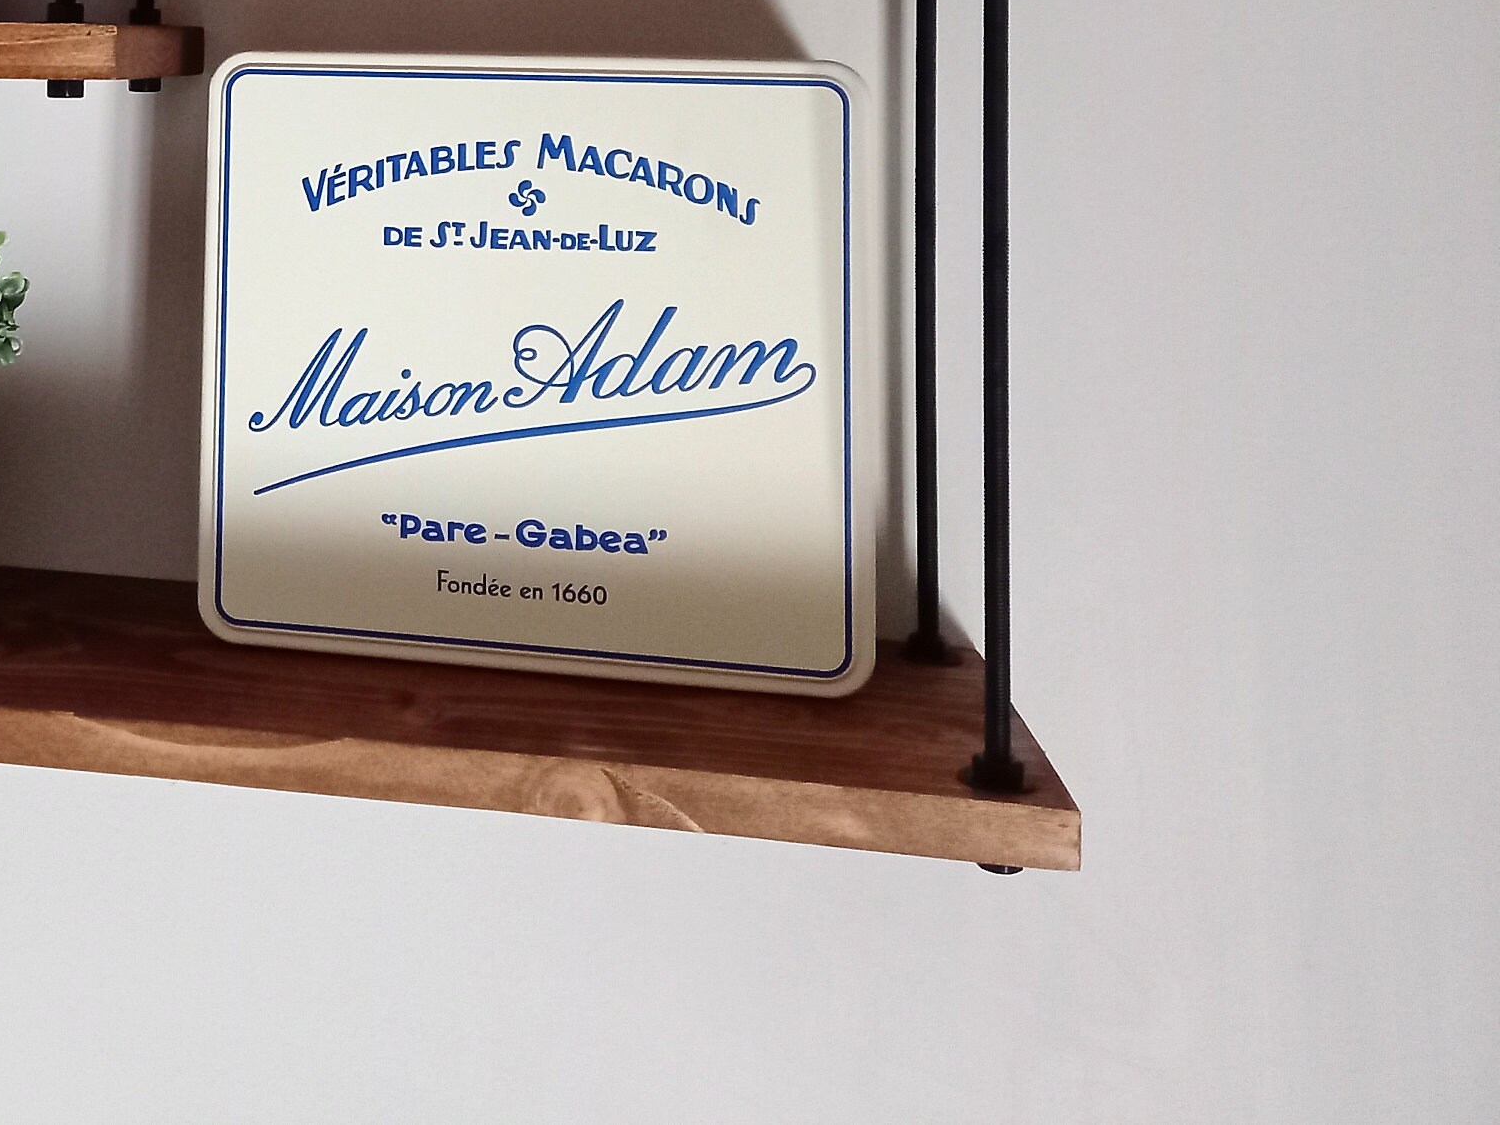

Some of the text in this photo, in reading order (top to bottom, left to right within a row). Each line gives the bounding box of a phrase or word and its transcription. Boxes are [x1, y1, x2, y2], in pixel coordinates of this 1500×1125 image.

[300, 131, 762, 226] VÉRITABLES MACARONS
[383, 226, 422, 247] DE
[470, 221, 658, 252] JEAN-DE-LUZ
[248, 298, 817, 434] Maison Adam
[437, 569, 608, 606] Fondée en 1660
